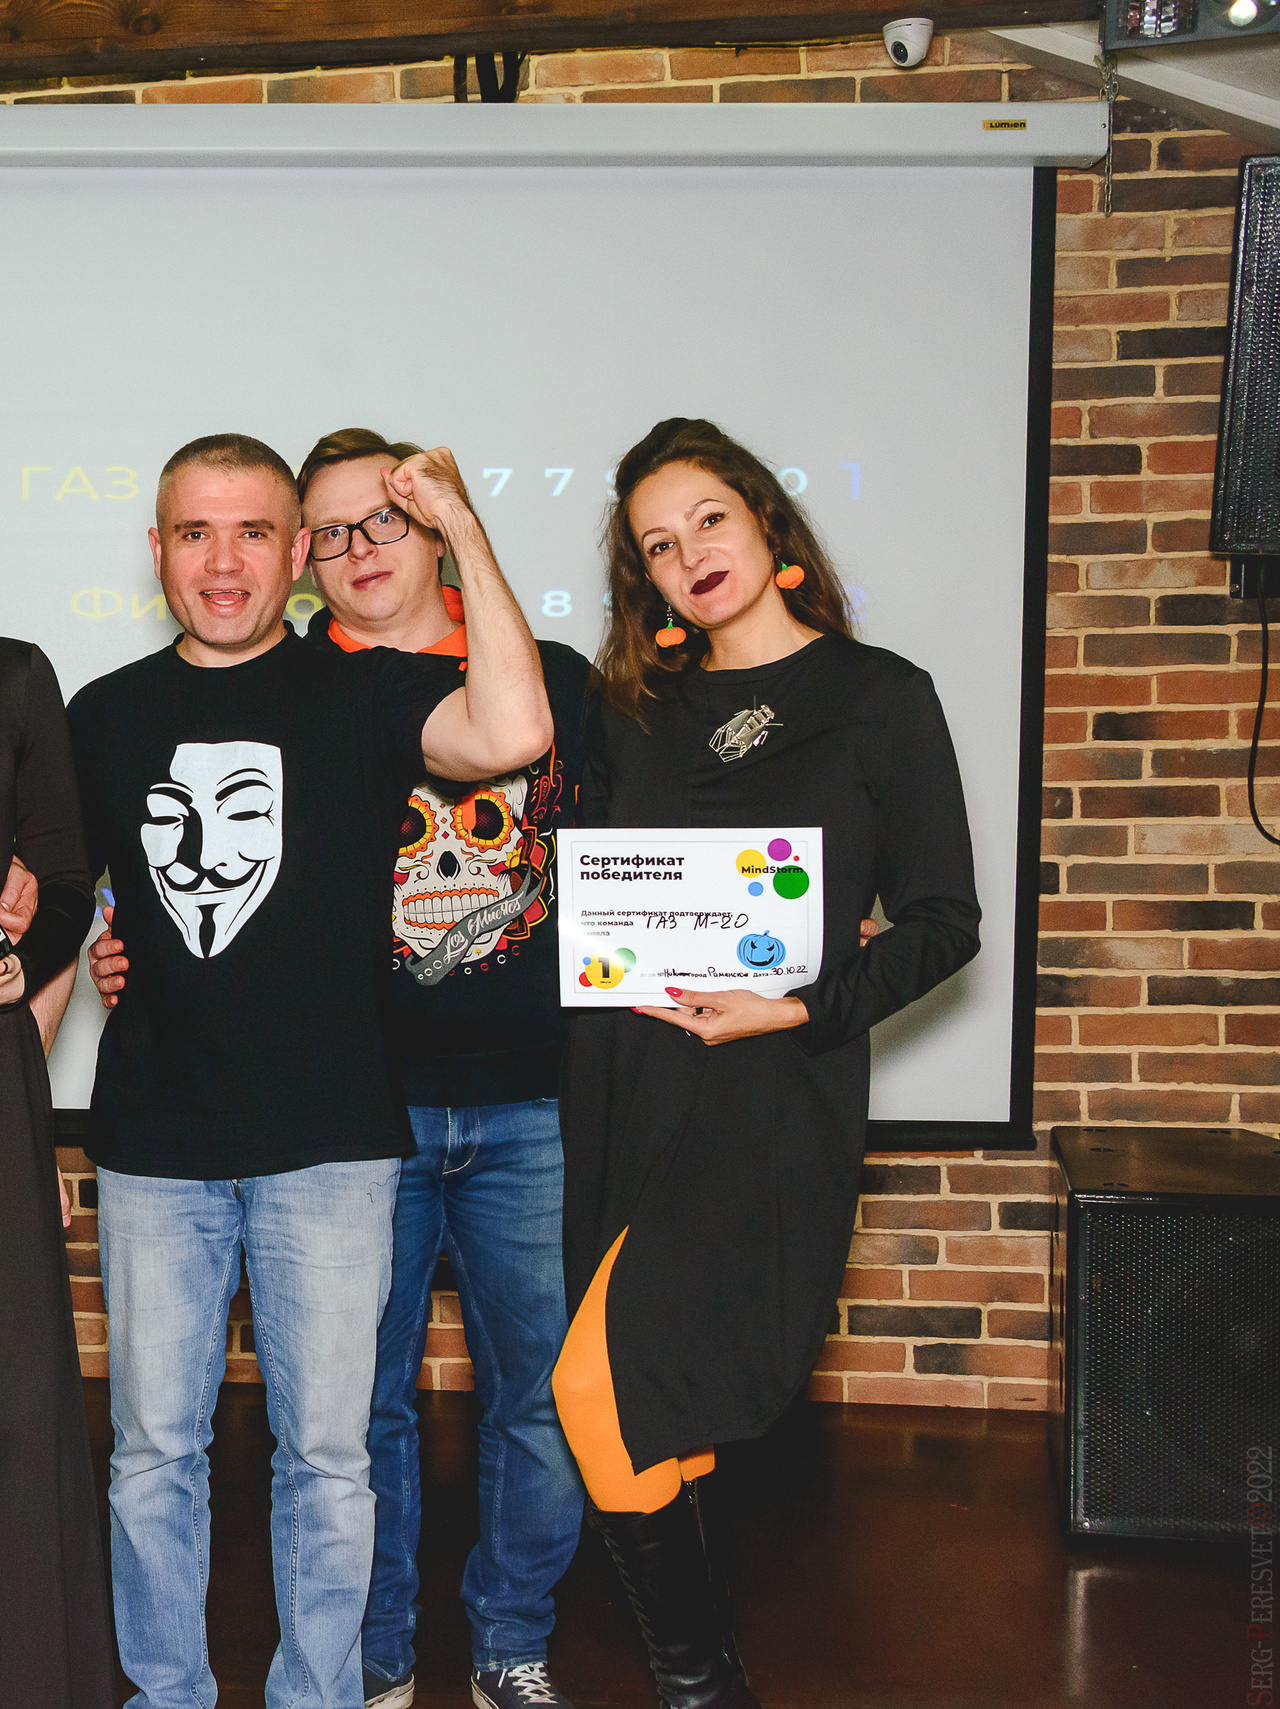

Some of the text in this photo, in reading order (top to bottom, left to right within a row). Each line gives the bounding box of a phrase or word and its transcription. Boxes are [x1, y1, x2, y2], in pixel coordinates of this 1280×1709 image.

[20, 465, 140, 502] ГАЗ
[482, 467, 513, 497] 7
[544, 467, 575, 497] 7
[840, 461, 862, 498] 1
[541, 589, 573, 618] 8
[579, 853, 685, 868] Сертификат
[741, 865, 804, 874] MindStorm
[580, 867, 683, 882] победителя
[581, 909, 615, 917] Данный
[616, 909, 667, 918] сертификат
[646, 913, 750, 931] ГАЗ М-20
[443, 890, 525, 965] Los Muertos
[598, 957, 610, 978] 1
[771, 965, 807, 976] 30.10.22
